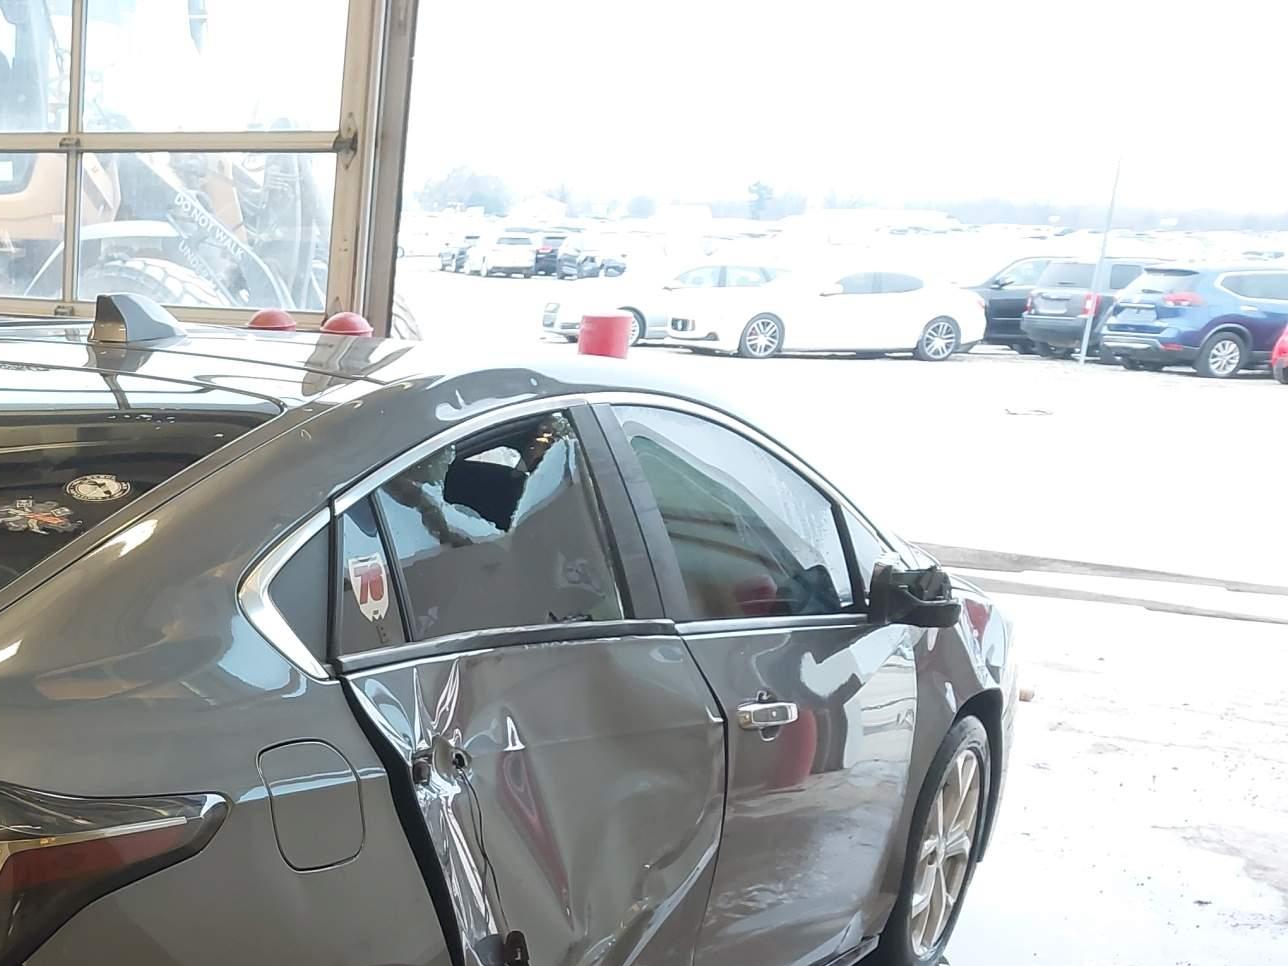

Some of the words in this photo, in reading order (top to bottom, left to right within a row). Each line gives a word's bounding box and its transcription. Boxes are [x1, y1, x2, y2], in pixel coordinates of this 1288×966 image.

[174, 191, 191, 211] DO
[191, 207, 215, 232] NOT
[215, 227, 244, 261] WALK
